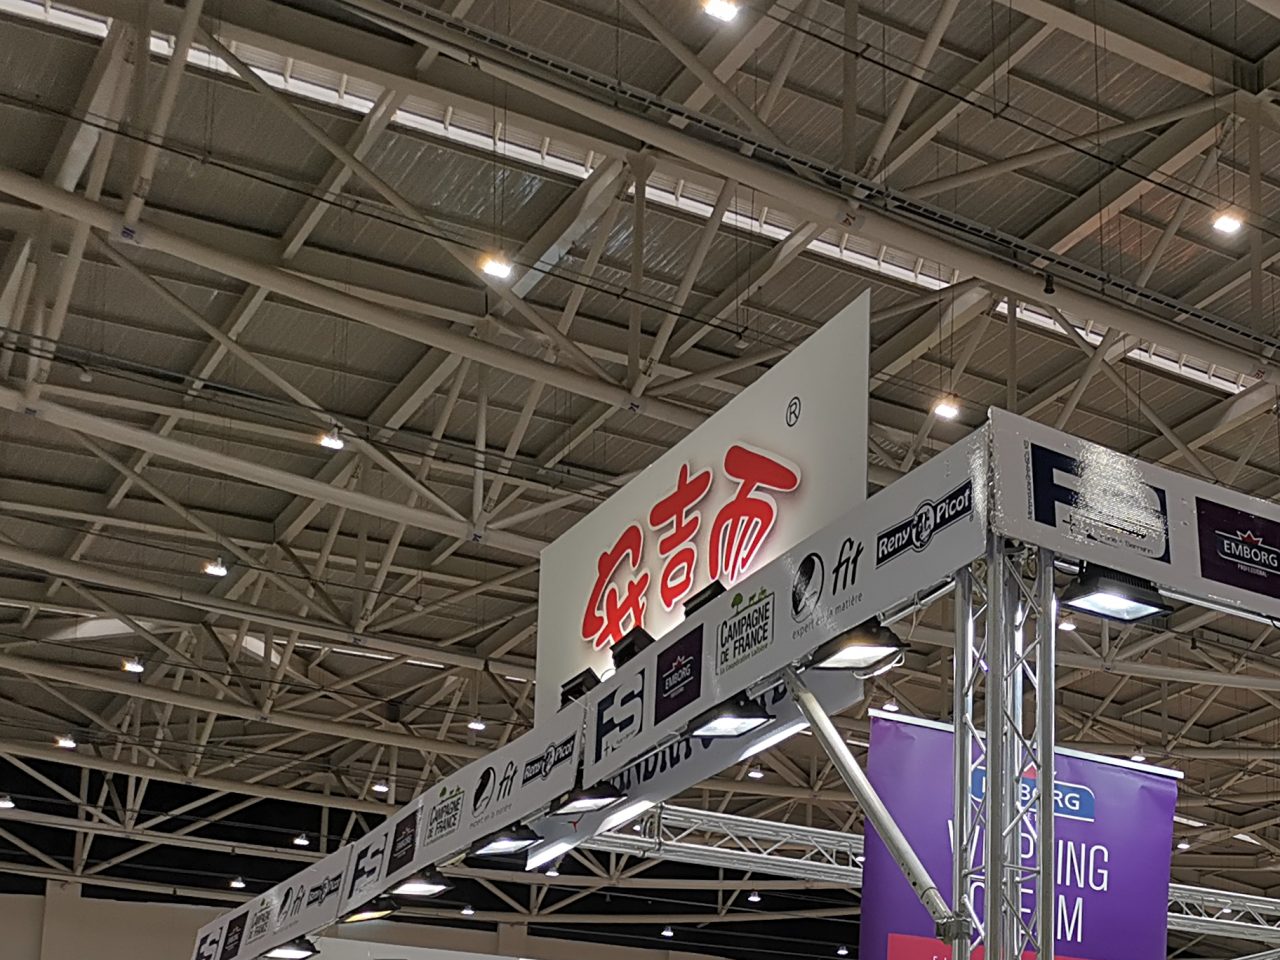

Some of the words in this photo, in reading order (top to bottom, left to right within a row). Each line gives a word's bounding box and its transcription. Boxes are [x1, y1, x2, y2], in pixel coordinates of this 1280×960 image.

[878, 527, 909, 558] Reny
[1223, 540, 1279, 568] EMBORG
[832, 537, 864, 597] fit
[834, 592, 863, 615] matière
[720, 600, 771, 649] CAMPAGNE
[720, 649, 730, 665] DE
[732, 625, 769, 661] FRANCE
[665, 664, 692, 690] EMBORG
[595, 668, 645, 764] FS
[497, 760, 518, 802] fit
[429, 795, 462, 826] CAMPAGNE
[348, 832, 388, 900] FS
